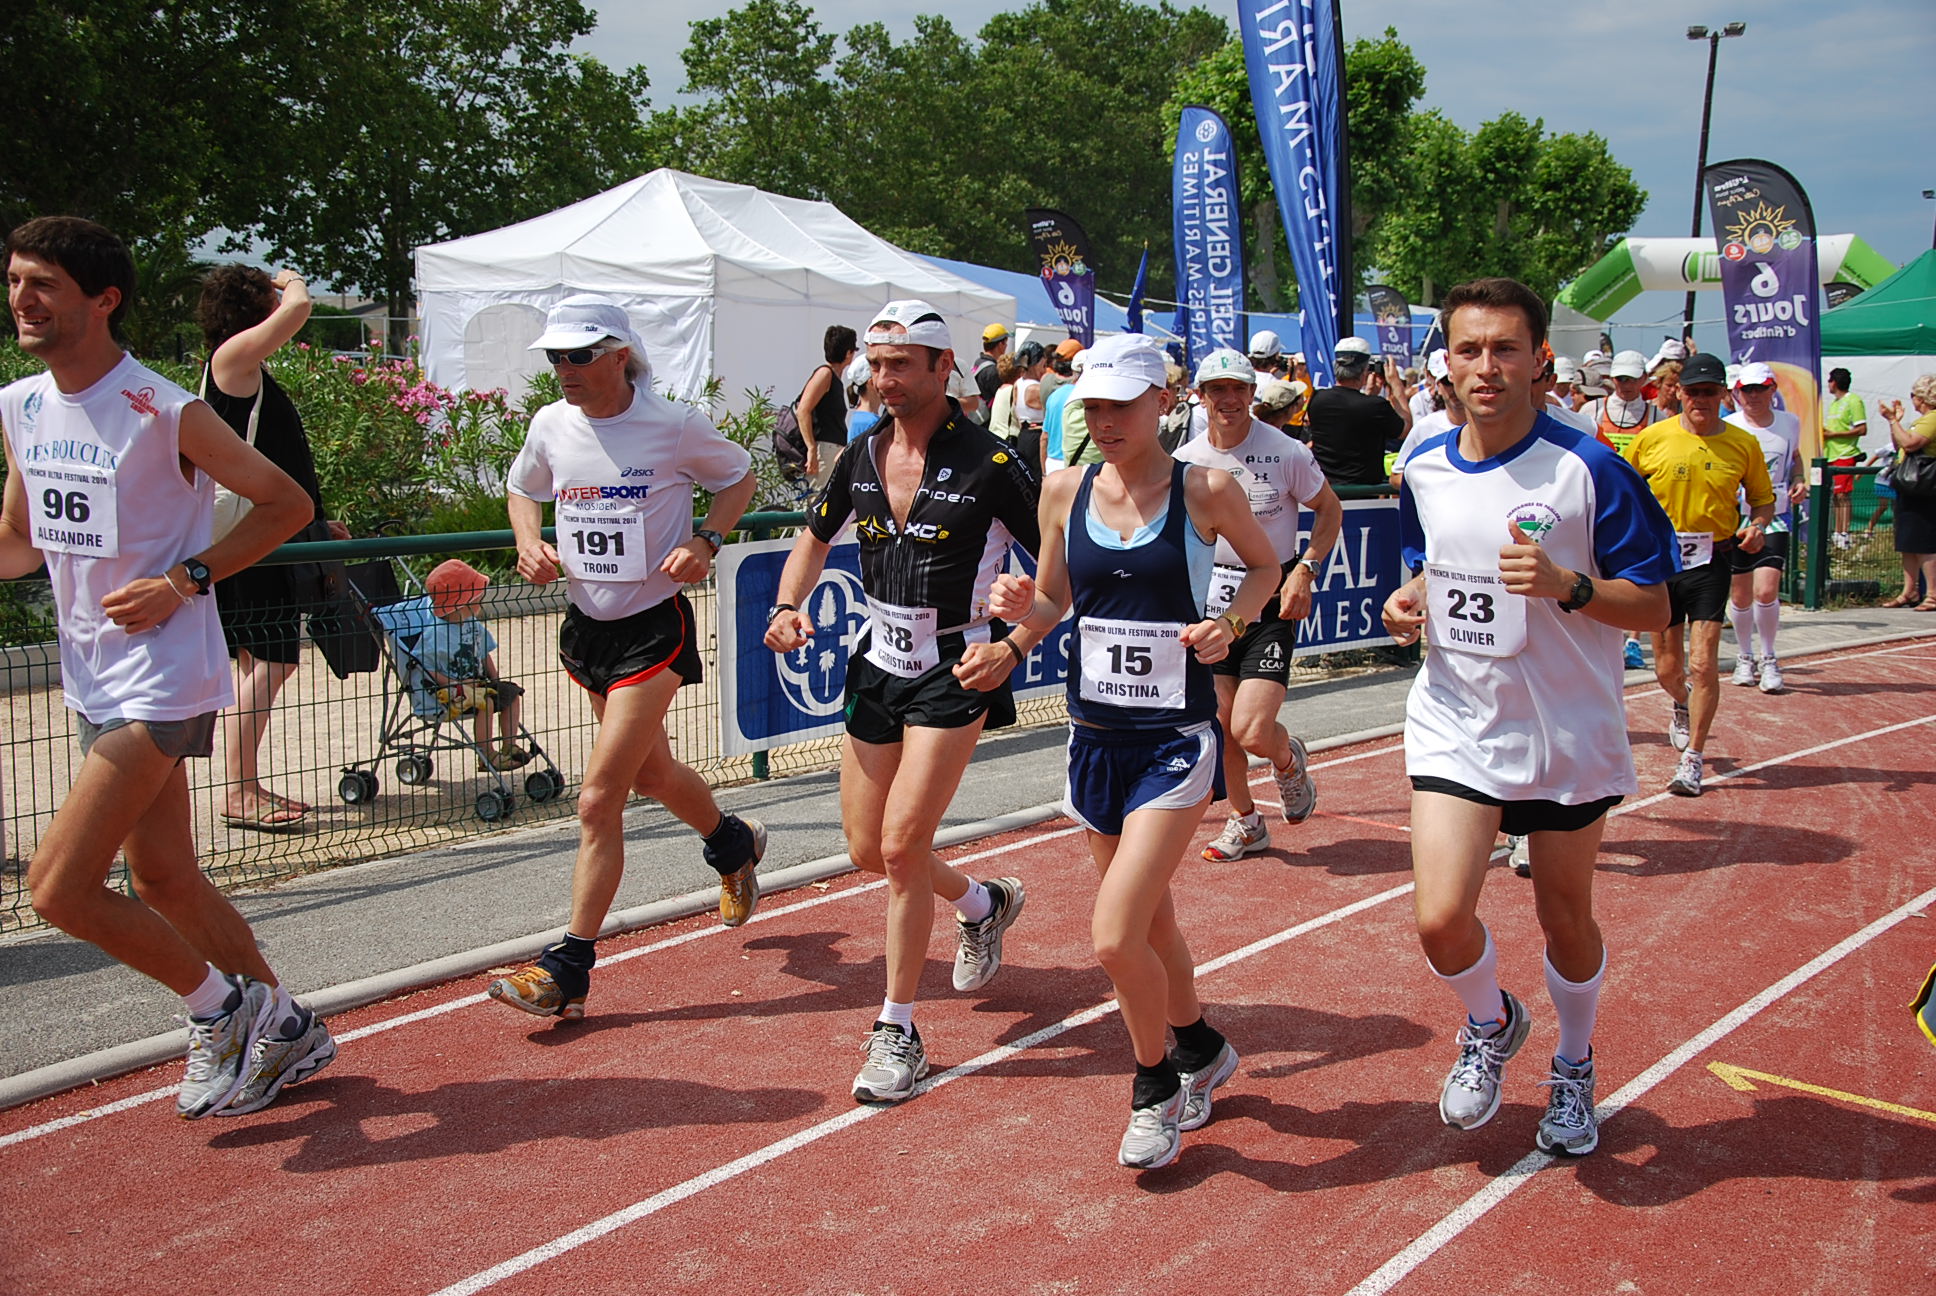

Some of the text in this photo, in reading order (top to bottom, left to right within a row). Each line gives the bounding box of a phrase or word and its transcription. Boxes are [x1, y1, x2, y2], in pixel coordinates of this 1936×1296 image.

[26, 440, 119, 471] LES BOUCLES
[64, 473, 90, 484] FESTIVAL
[559, 484, 650, 501] INTERSPORT
[43, 488, 91, 523] 96
[597, 517, 621, 525] FESTIVAL
[38, 526, 103, 548] ALEXANDRE
[571, 530, 625, 556] 191
[583, 562, 618, 574] TROND
[1430, 568, 1449, 579] FRENCH
[1451, 572, 1466, 582] ULTRA
[1468, 574, 1495, 584] FESTIVAL
[1447, 588, 1495, 623] 23
[881, 620, 914, 653] 38
[1085, 624, 1179, 638] FRENCH ULTRA FESTIVAL 2010
[1450, 627, 1495, 646] OLIVIER
[878, 649, 923, 671] CHRISTIAN
[1106, 643, 1153, 676] 15
[1097, 680, 1160, 699] CRISTINA
